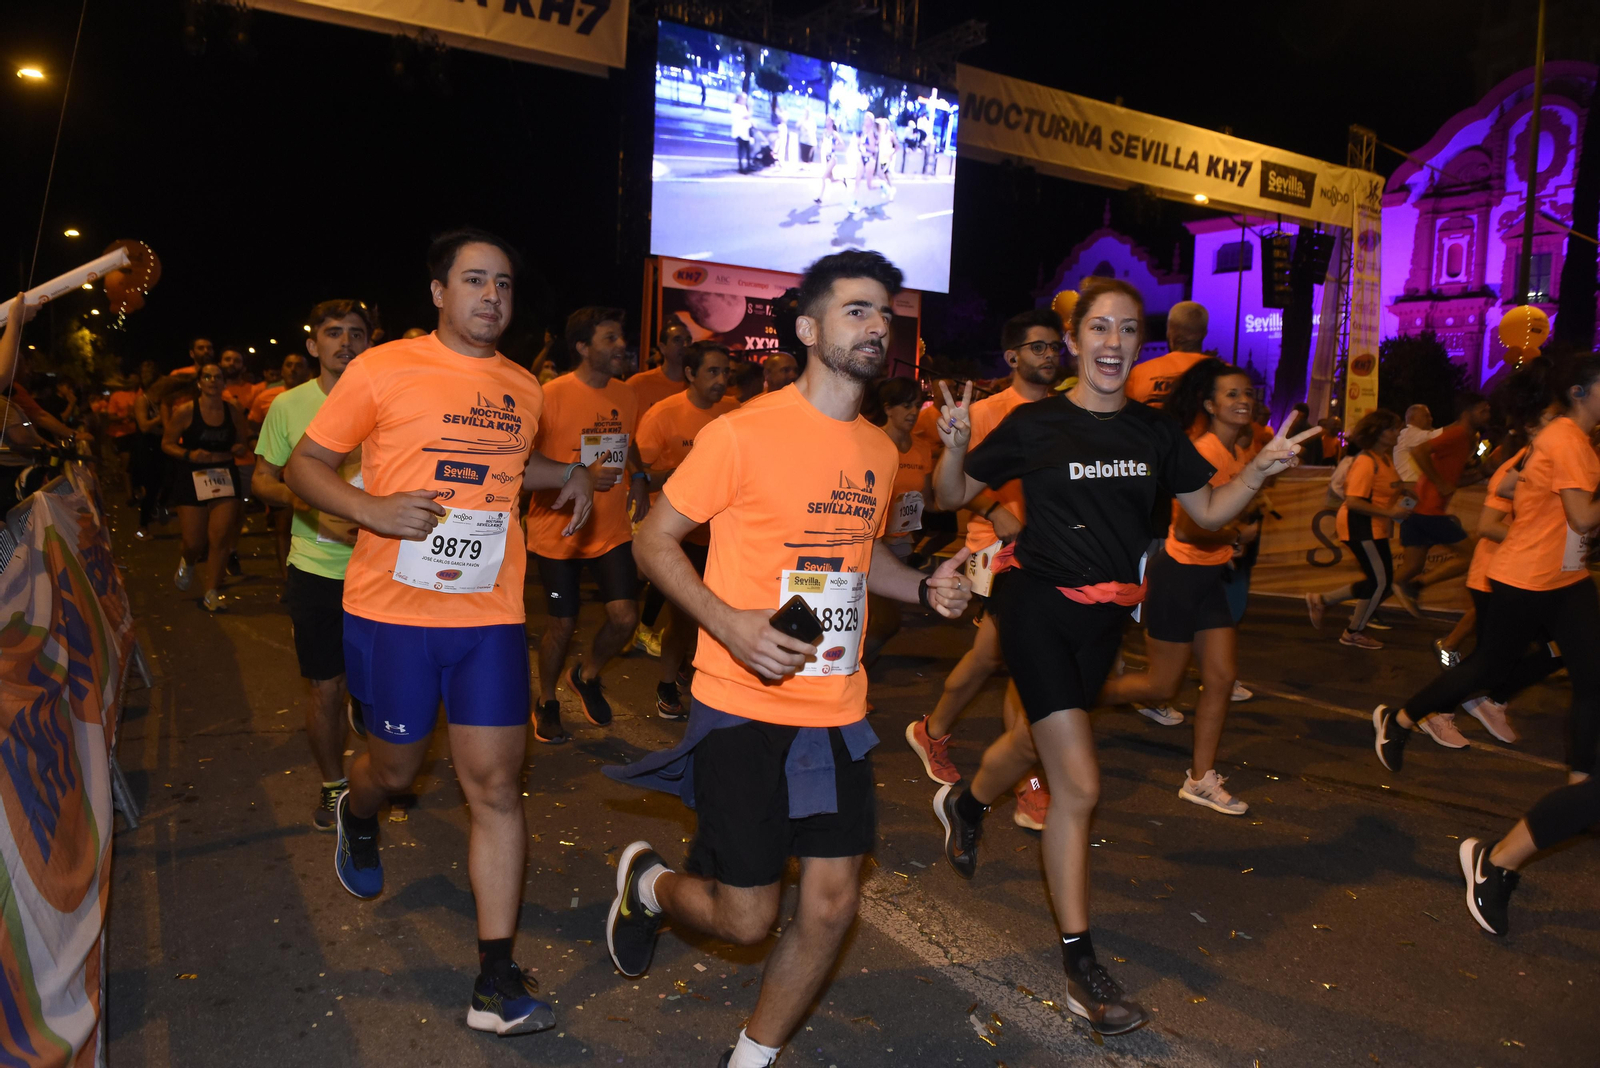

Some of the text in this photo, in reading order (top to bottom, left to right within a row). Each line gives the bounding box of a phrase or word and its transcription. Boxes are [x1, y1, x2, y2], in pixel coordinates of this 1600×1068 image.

[962, 92, 1103, 151] NOCTURNA
[1108, 129, 1200, 175] SEVILLA
[442, 413, 495, 430] SEVILLA
[470, 407, 522, 424] NOCTURNA
[830, 490, 877, 507] NOCTURNA
[807, 502, 852, 515] SEVILLA
[899, 504, 918, 517] 13094
[431, 535, 482, 560] 9879
[433, 557, 450, 565] CARLOS
